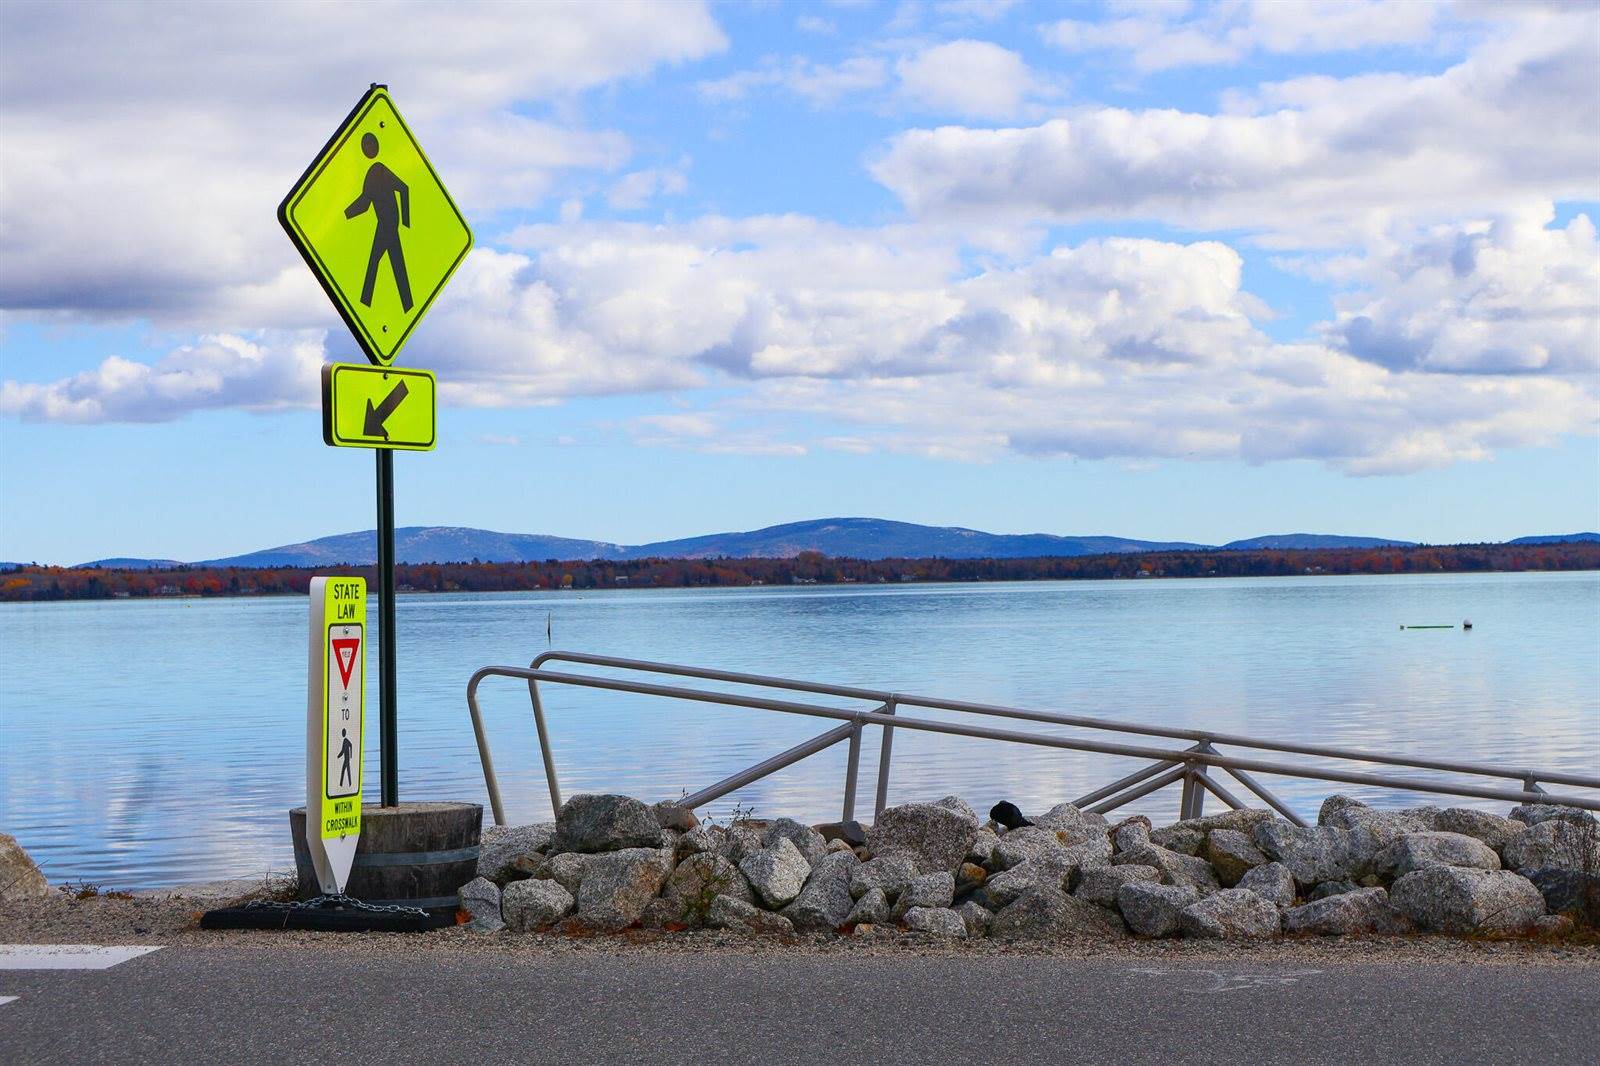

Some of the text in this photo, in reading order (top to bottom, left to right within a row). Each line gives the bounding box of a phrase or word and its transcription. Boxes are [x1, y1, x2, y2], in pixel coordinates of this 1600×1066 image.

[334, 584, 359, 600] STATE
[337, 603, 356, 619] LAW
[341, 708, 350, 721] TO
[334, 801, 353, 814] WITHIN
[326, 816, 358, 832] CROSSWALK
